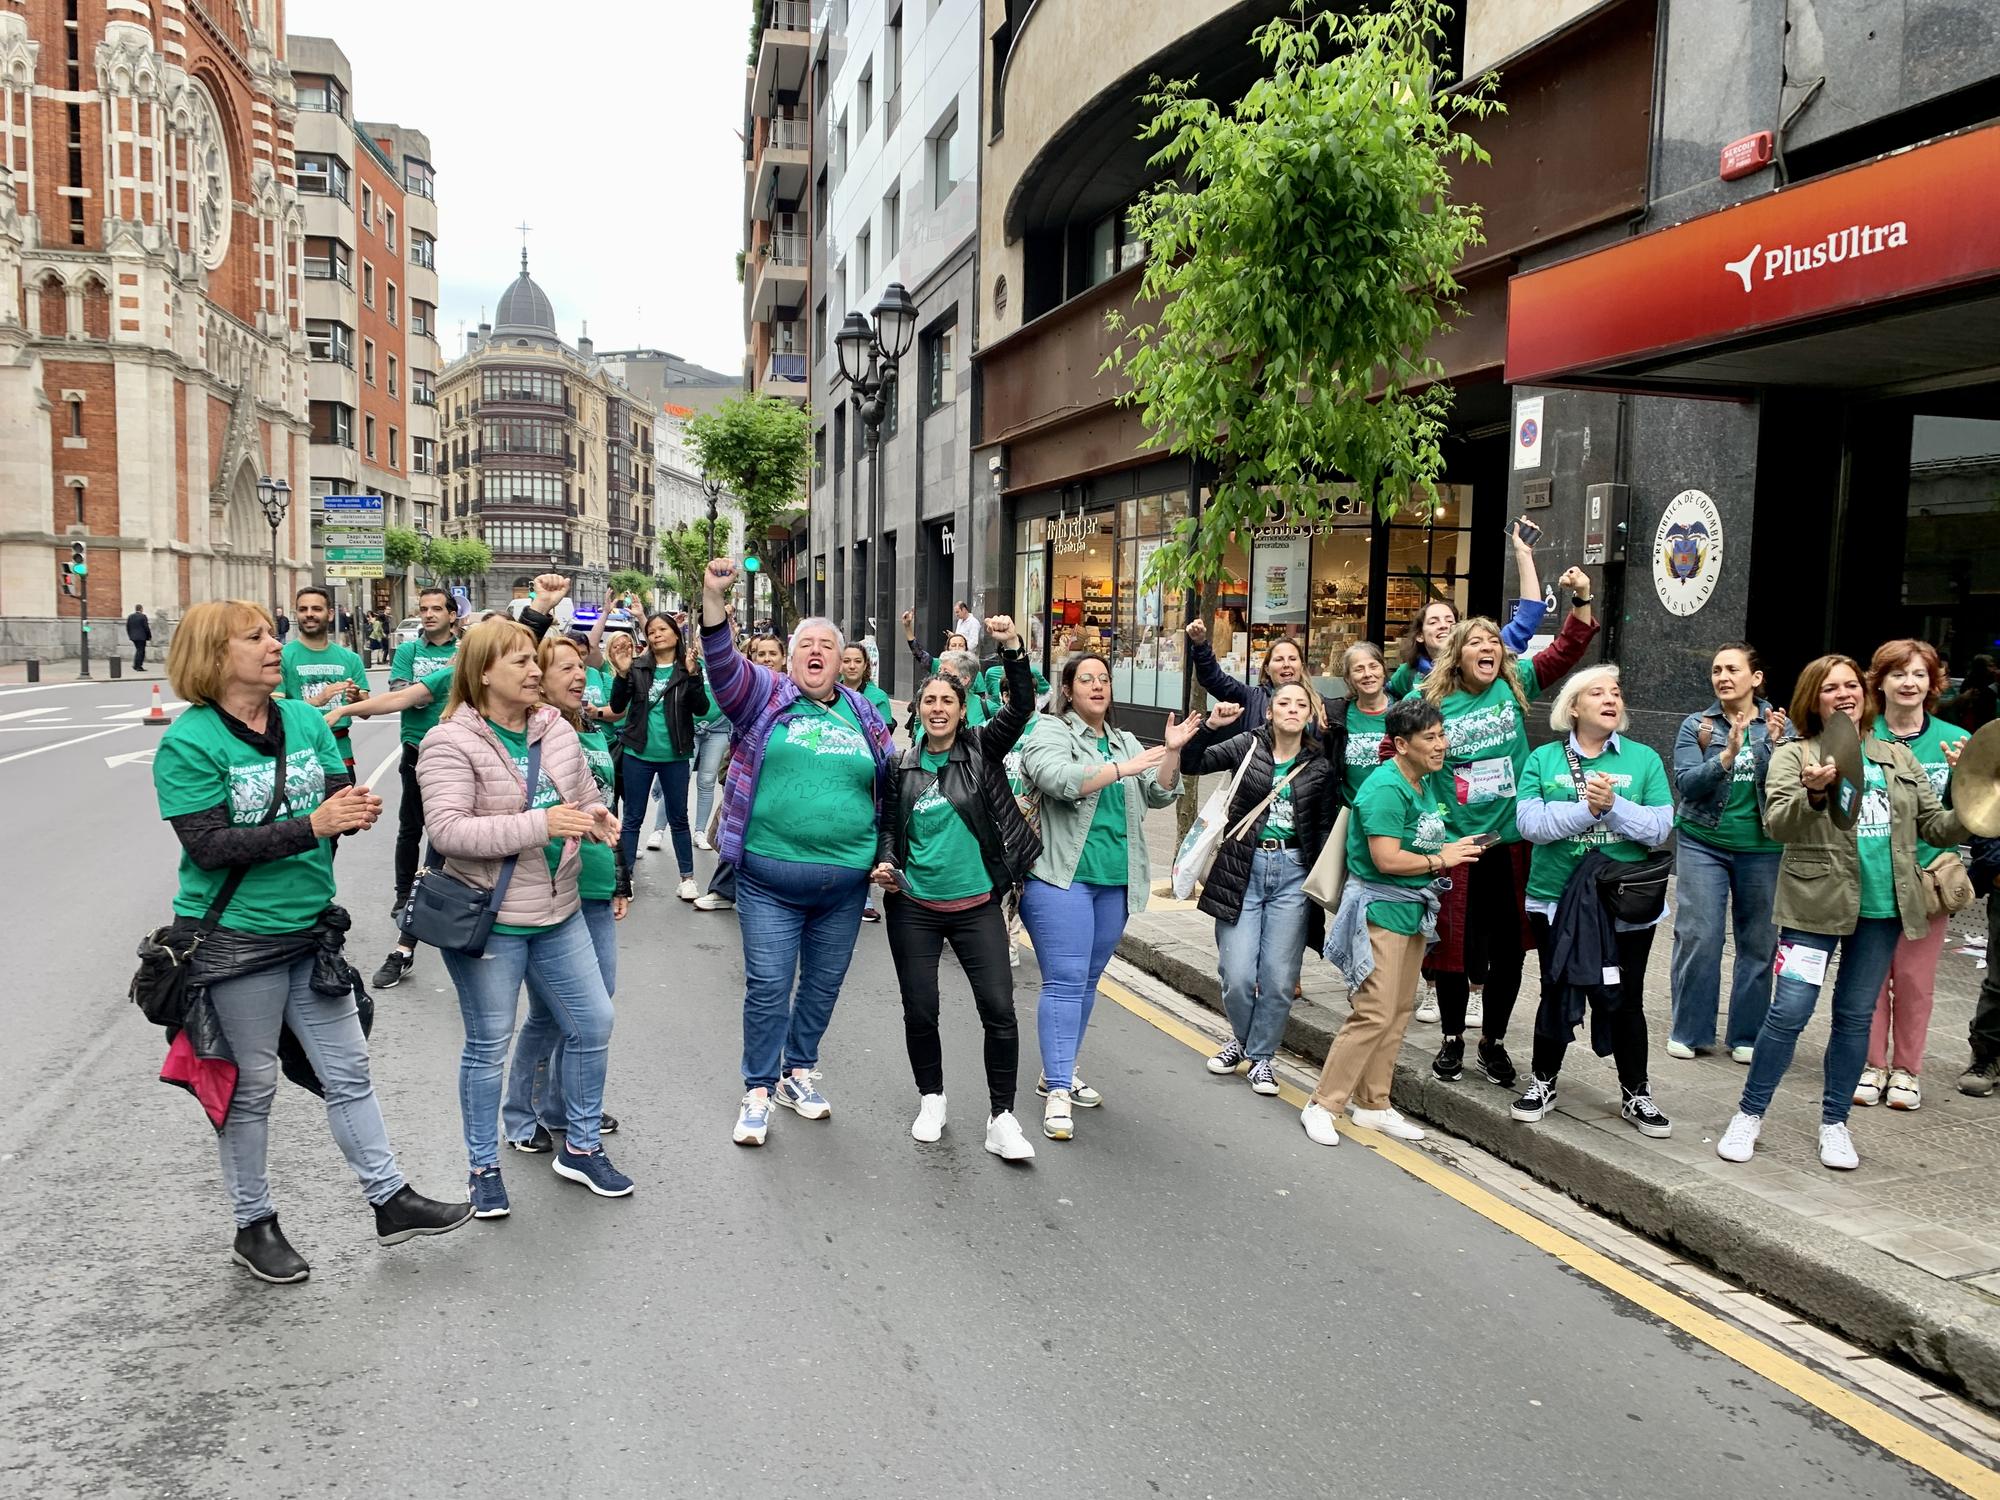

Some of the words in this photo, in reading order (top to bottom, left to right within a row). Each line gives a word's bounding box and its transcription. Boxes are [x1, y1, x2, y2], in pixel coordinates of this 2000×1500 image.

[1763, 221, 1908, 281] PlusUltra
[1655, 499, 1682, 555] REPUBLICA
[1684, 494, 1694, 503] DE
[1695, 496, 1719, 551] COLOMBIA
[1657, 574, 1714, 613] CONSULADO
